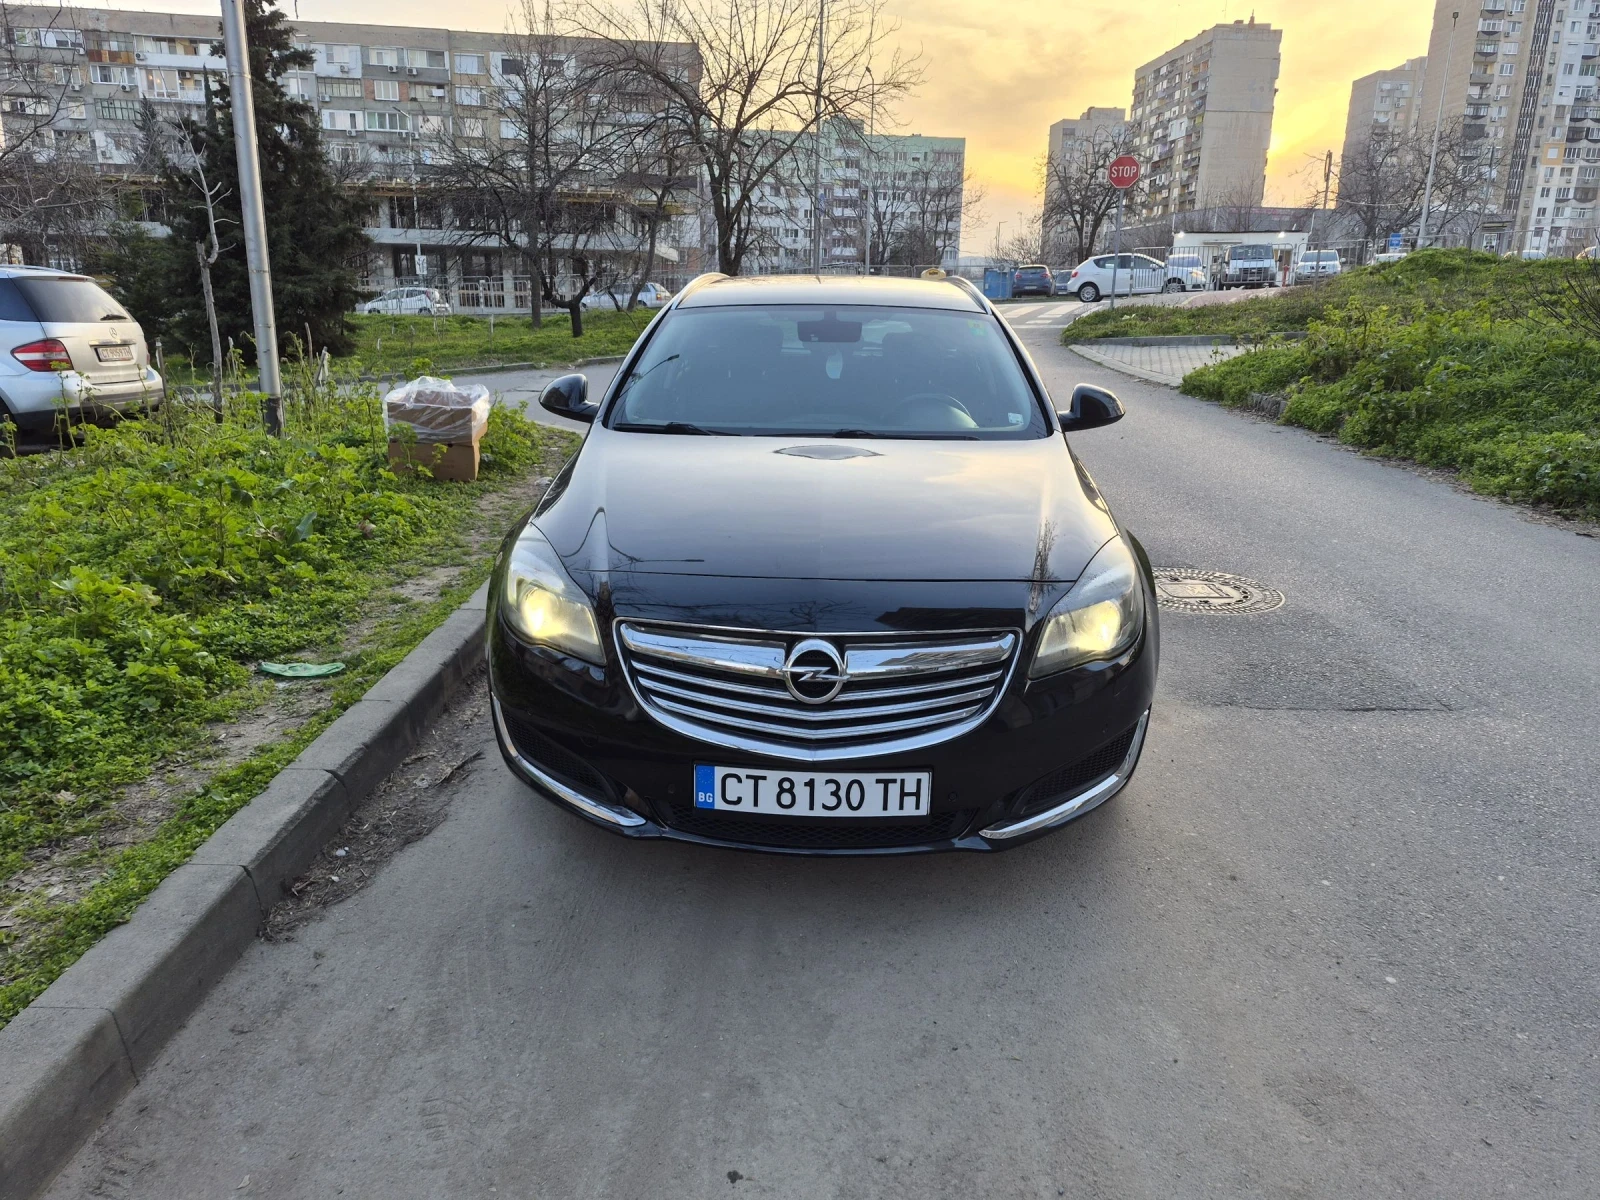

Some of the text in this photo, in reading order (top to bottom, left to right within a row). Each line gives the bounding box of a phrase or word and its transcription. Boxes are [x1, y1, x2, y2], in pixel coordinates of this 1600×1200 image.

[1111, 166, 1137, 178] STOP
[698, 791, 713, 803] BG
[720, 773, 922, 811] CT 8130 TH
